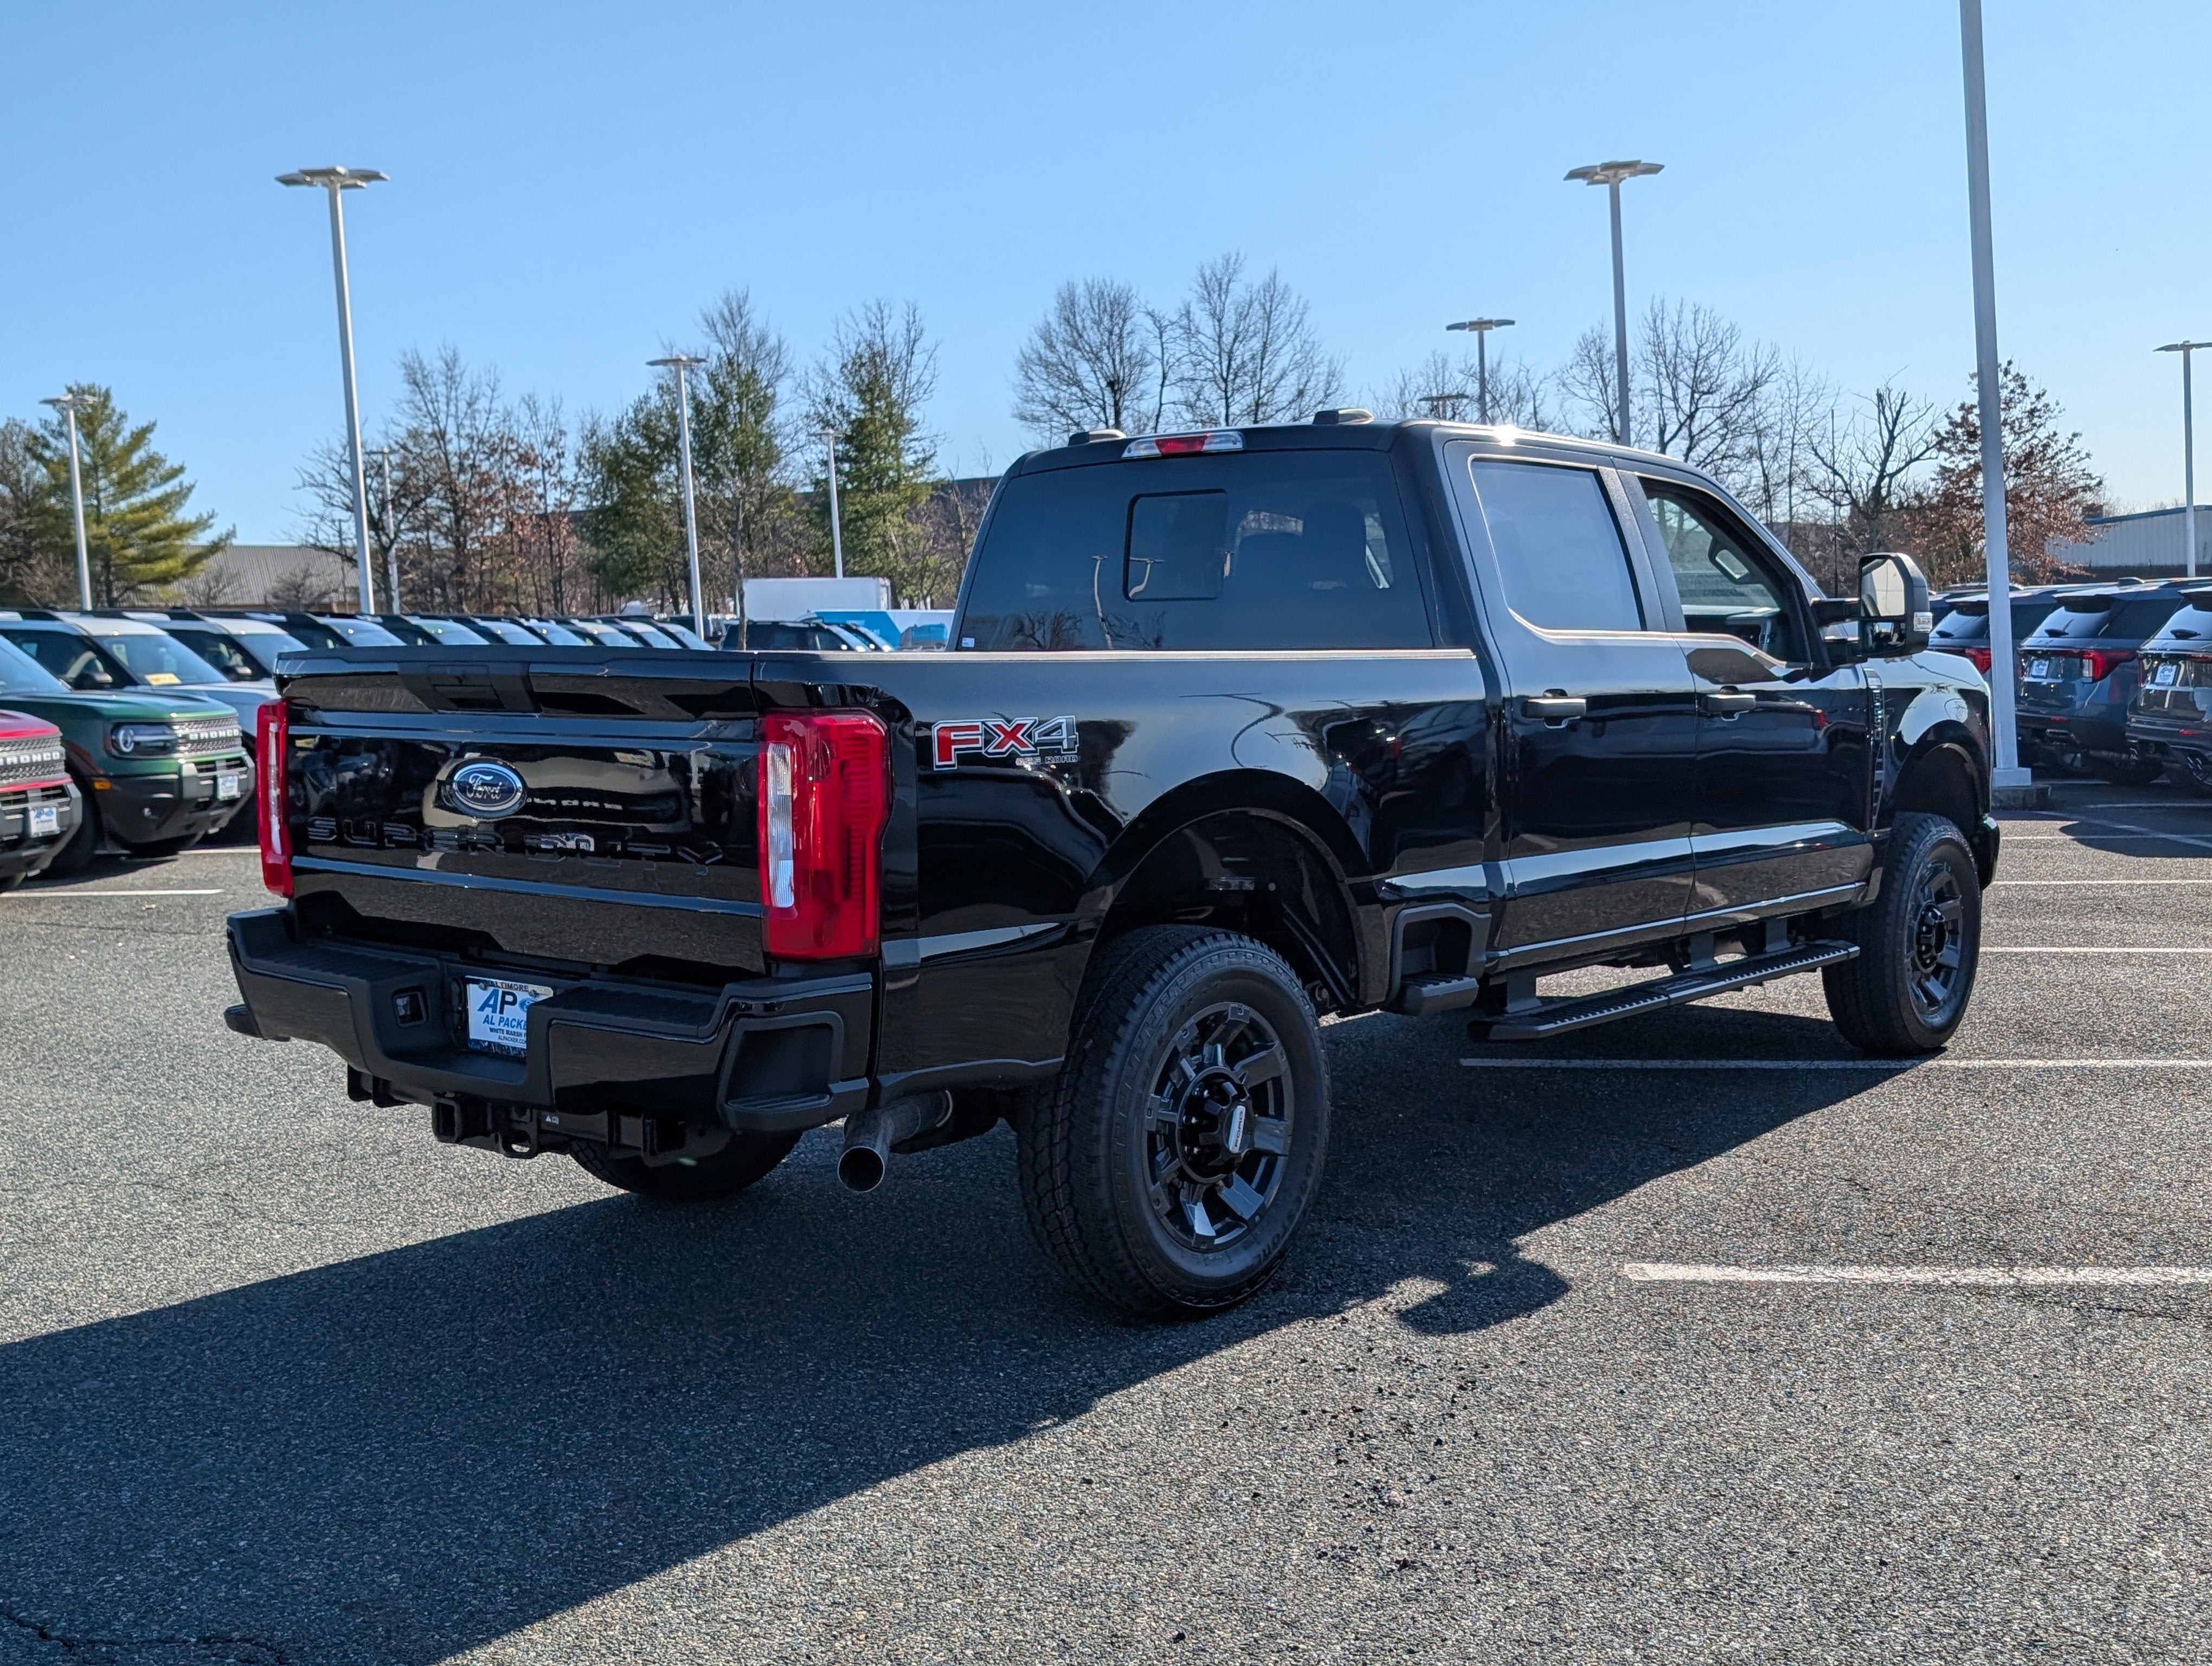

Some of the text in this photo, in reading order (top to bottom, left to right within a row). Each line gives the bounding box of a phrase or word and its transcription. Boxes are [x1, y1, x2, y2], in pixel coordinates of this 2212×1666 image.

[189, 729, 240, 740] BRONCO
[931, 715, 1079, 771] FX4
[0, 751, 61, 766] RONCO
[1045, 754, 1078, 764] ROAD
[466, 773, 503, 800] Ford
[307, 816, 723, 876] SUPER DUTY
[486, 981, 529, 992] BALTIMORE
[477, 989, 518, 1015] AP
[483, 1014, 496, 1026] AL
[489, 1027, 505, 1035] WHITE
[505, 1029, 523, 1037] MARSH
[498, 1035, 527, 1045] ALPACKER.CO
